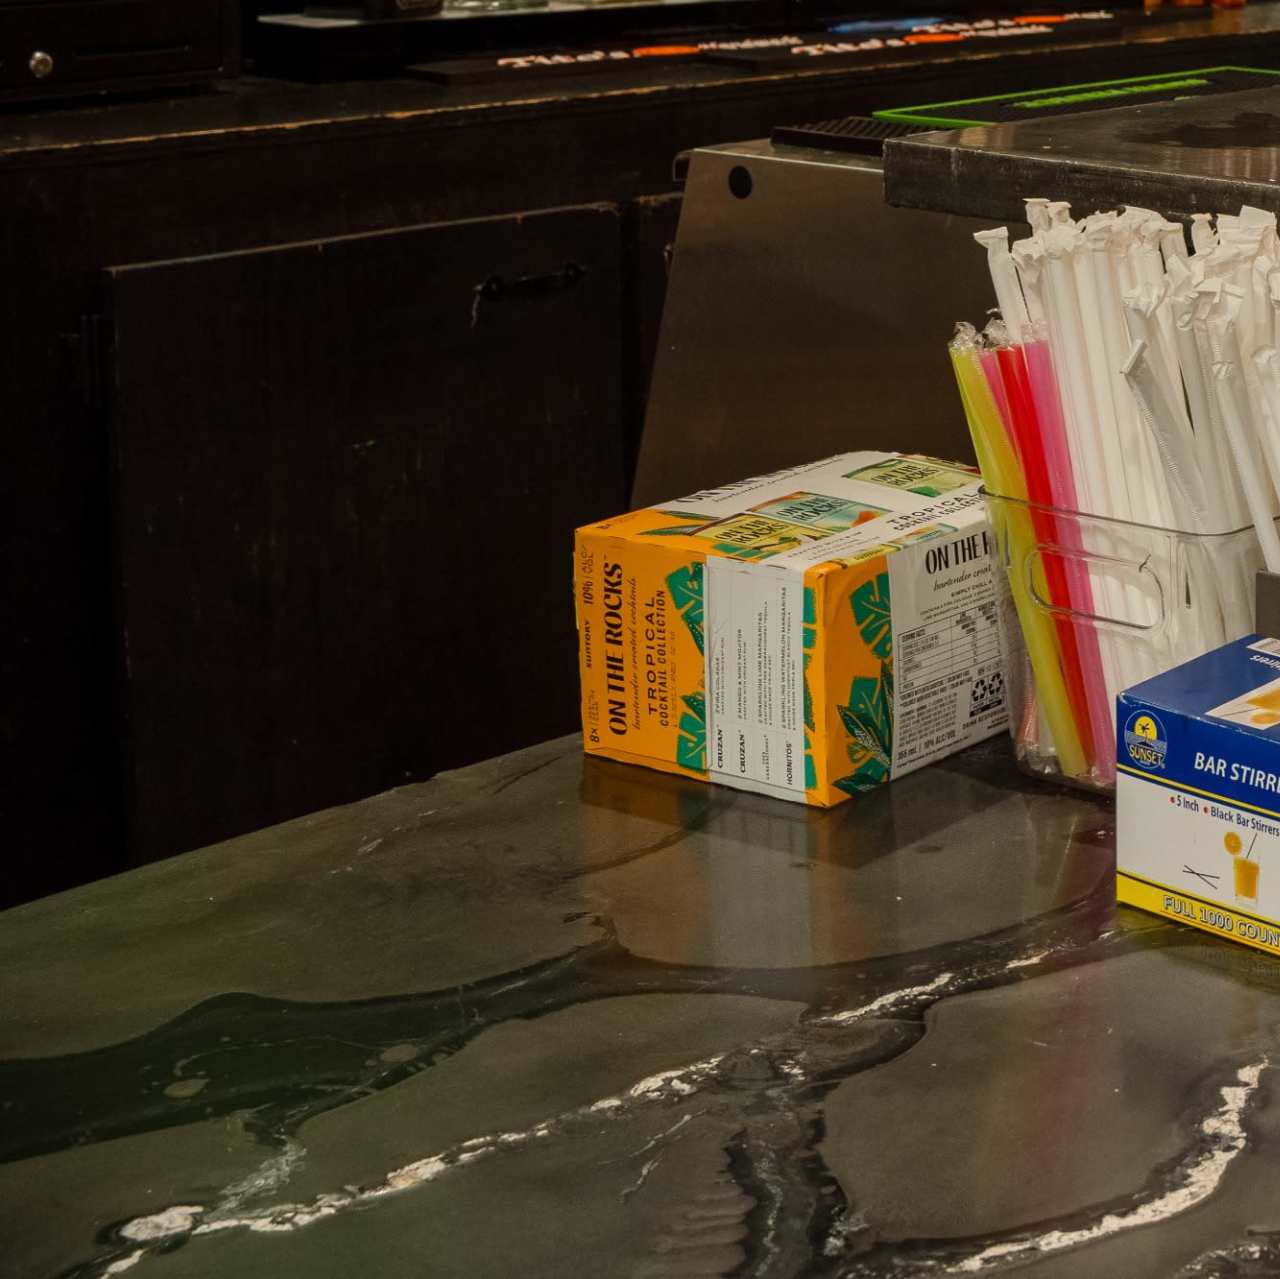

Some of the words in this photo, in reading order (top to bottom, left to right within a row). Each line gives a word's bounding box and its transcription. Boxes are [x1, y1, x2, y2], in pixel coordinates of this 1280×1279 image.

[792, 499, 848, 523] ROCKS
[886, 492, 978, 524] TROPICAL
[732, 522, 790, 545] ROCKS
[925, 544, 949, 575] ON
[951, 533, 982, 566] THE
[581, 580, 594, 607] 10%
[603, 563, 624, 647] ROCKS
[584, 618, 592, 670] SUNTORY
[655, 589, 667, 664] COLLECTION
[604, 648, 625, 694] THE
[644, 595, 658, 716] TROPICAL
[607, 699, 628, 736] ON
[656, 670, 669, 727] COCKTAIL
[785, 743, 793, 786] HORNITOS
[1128, 744, 1164, 765] SUNSET
[1194, 751, 1227, 777] BAR
[1176, 794, 1182, 808] 5
[1183, 796, 1199, 813] Inch
[1210, 805, 1234, 824] Black
[1236, 813, 1250, 828] Bar
[1251, 817, 1280, 838] Stirrers
[1162, 894, 1197, 920] FULL
[1199, 906, 1234, 933] 1000
